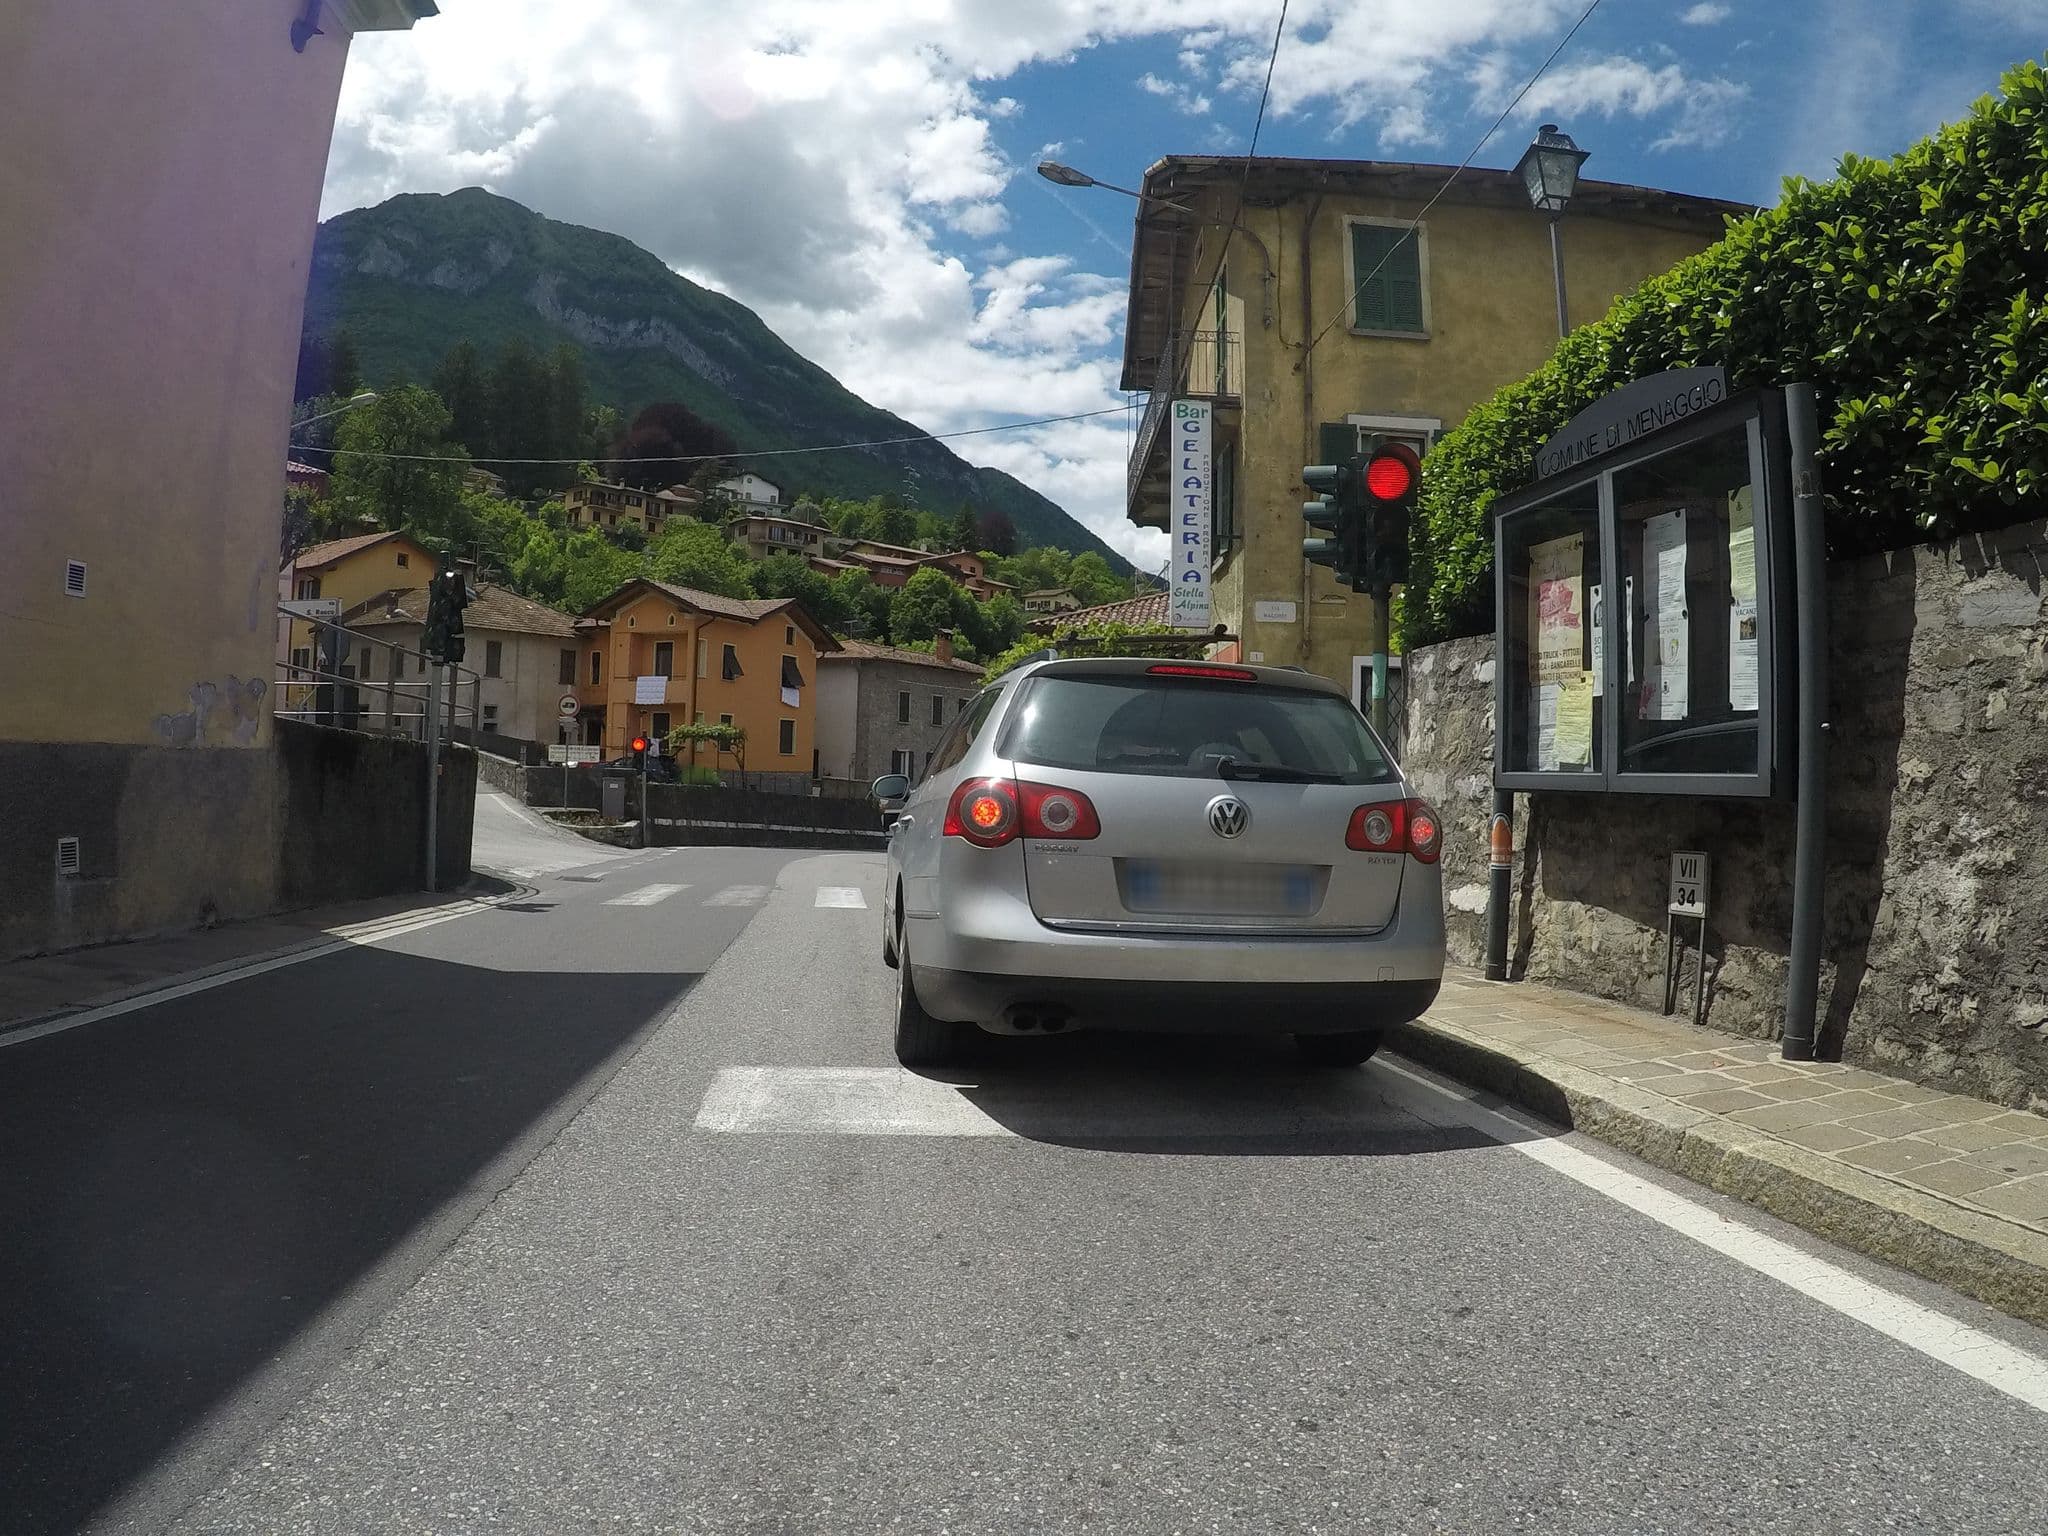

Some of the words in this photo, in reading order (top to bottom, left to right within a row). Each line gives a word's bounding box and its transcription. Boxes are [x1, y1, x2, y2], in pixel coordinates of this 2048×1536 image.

[1176, 403, 1209, 419] Bar
[1539, 433, 1600, 477] COMUNE
[1605, 423, 1622, 449] DI
[1627, 378, 1722, 440] MENAGGIO
[1182, 420, 1202, 583] GELATERIA
[1173, 587, 1204, 598] Stella
[1175, 600, 1210, 612] Alpina
[1680, 858, 1697, 878] VII
[1677, 887, 1696, 907] 34
